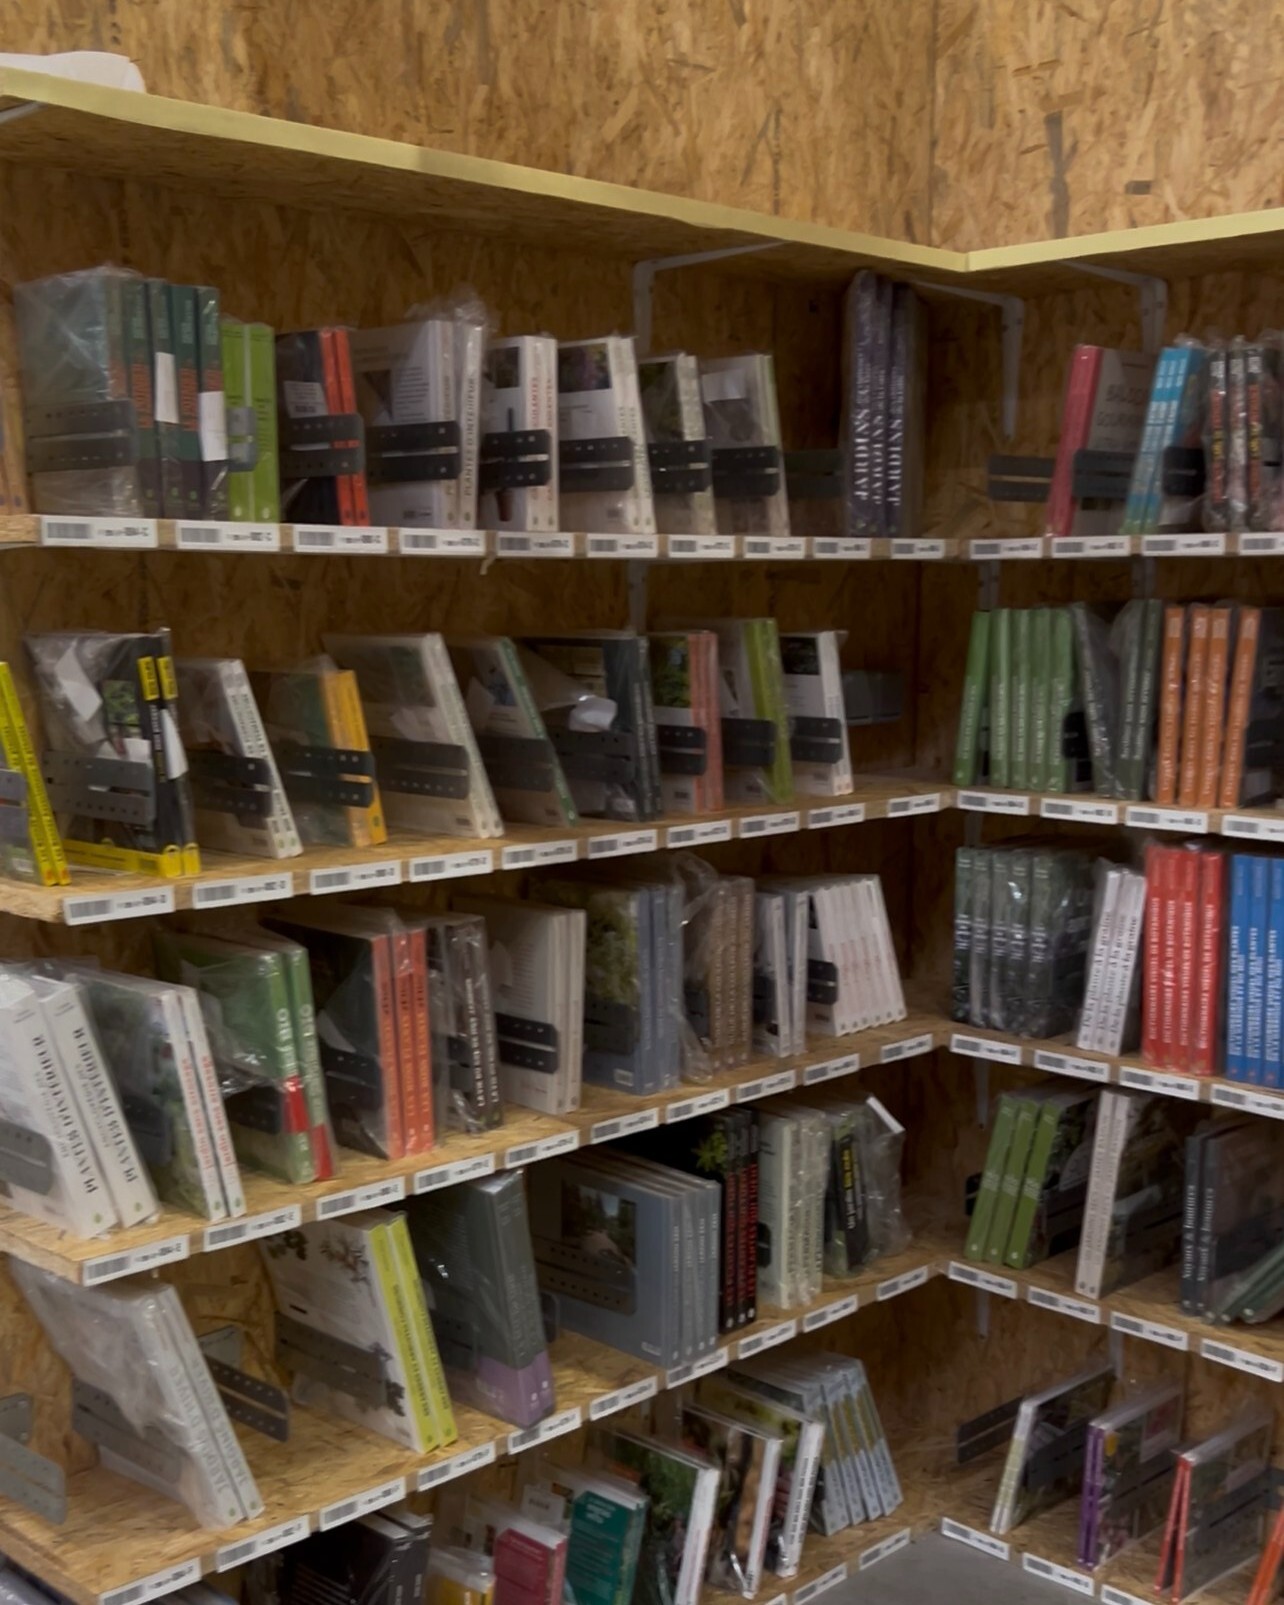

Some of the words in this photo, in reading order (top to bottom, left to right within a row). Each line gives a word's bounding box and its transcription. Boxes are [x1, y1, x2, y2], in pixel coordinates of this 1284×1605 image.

[854, 409, 870, 500] JARDINS
[871, 415, 884, 505] JARDINS
[887, 419, 903, 506] JARDINS
[1150, 897, 1159, 942] BOTANIQUE
[1167, 900, 1175, 945] BOTANIQUE
[1183, 902, 1192, 947] BOTANIQUE
[1203, 904, 1214, 950] BOTANIQUE
[1087, 969, 1102, 1001] plante
[1098, 911, 1111, 946] graine
[1102, 970, 1115, 1003] plante
[1113, 914, 1125, 948] graine
[1115, 974, 1129, 1006] plante
[1126, 917, 1138, 951] graine
[1150, 957, 1158, 982] VISUEL
[1181, 962, 1191, 987] VISUEL
[1200, 964, 1211, 990] VISUEL
[1149, 985, 1158, 1040] DICTIONNAIRE
[1163, 988, 1173, 1043] DICTIONNAIRE
[1180, 990, 1190, 1045] DICTIONNAIRE
[1199, 992, 1209, 1049] DICTIONNAIRE
[181, 1057, 199, 1106] arrosage
[201, 1055, 220, 1103] arrosage
[192, 1109, 204, 1134] sans
[212, 1106, 224, 1131] sans
[66, 1130, 98, 1194] PLANTES
[106, 1120, 138, 1183] PLANTES
[196, 1137, 214, 1169] jardin
[217, 1134, 235, 1167] jardin
[726, 1235, 735, 1285] PLANTES
[748, 1227, 756, 1275] PLANTES
[169, 1364, 200, 1427] D'HIVER
[197, 1429, 230, 1493] JARDINS
[216, 1426, 248, 1486] JARDINS
